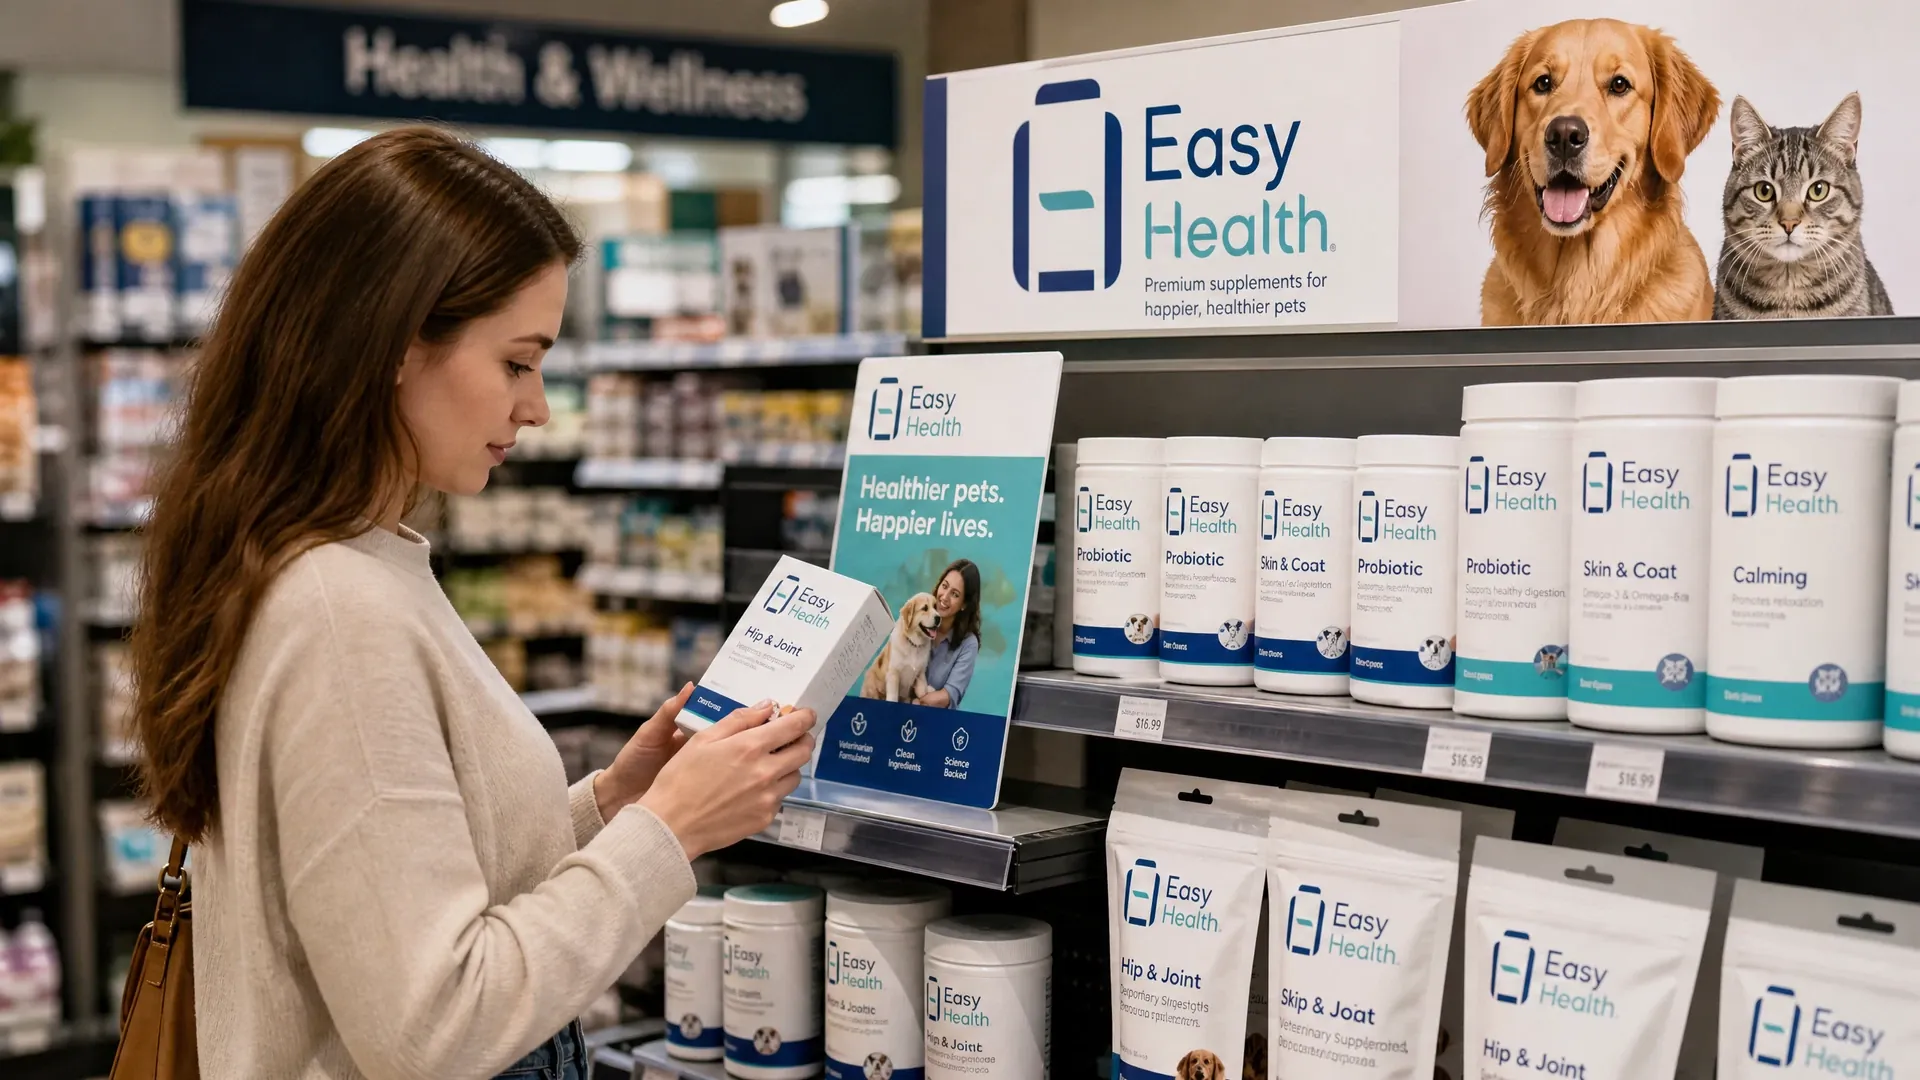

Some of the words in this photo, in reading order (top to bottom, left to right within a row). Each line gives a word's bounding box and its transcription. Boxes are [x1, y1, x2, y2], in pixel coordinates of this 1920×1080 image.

[343, 26, 526, 103] Health
[534, 41, 581, 108] &
[588, 44, 808, 122] Wellness
[1145, 104, 1301, 191] Easy
[1144, 275, 1205, 293] Premium
[1209, 273, 1302, 294] supplements
[1306, 271, 1328, 289] for
[1144, 300, 1203, 321] happier,
[1206, 299, 1270, 317] healthier
[1274, 298, 1307, 318] pets
[910, 385, 956, 415] Easy
[906, 416, 962, 437] Health
[1496, 465, 1547, 491] Easy
[1622, 461, 1680, 489] Easy
[1767, 463, 1828, 492] Easy
[860, 474, 949, 501] Healthier
[953, 479, 1004, 508] pets.
[1495, 491, 1557, 511] Health
[1621, 490, 1690, 510] Health
[1096, 494, 1133, 516] Easy
[1190, 496, 1230, 518] Easy
[1283, 498, 1322, 522] Easy
[1385, 499, 1428, 523] Easy
[1766, 493, 1838, 514] Health
[855, 507, 935, 541] Happier
[940, 511, 993, 538] lives.
[1095, 516, 1141, 531] Health
[1189, 517, 1237, 534] Health
[1281, 521, 1331, 538] Health
[1383, 523, 1437, 541] Health
[1077, 547, 1132, 563] Probiotic
[1166, 550, 1225, 567] Probiotic
[1261, 556, 1278, 571] Skin
[1281, 557, 1289, 571] &
[1291, 557, 1326, 573] Coat
[1358, 558, 1424, 576] Probiotic
[1466, 558, 1531, 576] Probiotic
[1584, 560, 1612, 577] Skin
[1616, 562, 1628, 578] &
[1633, 562, 1677, 580] Coat
[1733, 566, 1808, 590] Calming
[798, 587, 834, 614] Easy
[1493, 586, 1522, 597] healthy
[788, 604, 830, 630] Health
[745, 626, 764, 643] Hip
[764, 634, 774, 646] &
[774, 639, 802, 656] Joint
[1136, 717, 1161, 731] $16.99
[839, 740, 873, 753] Veterinarian
[839, 751, 870, 764] Formulated
[895, 748, 915, 759] Clean
[888, 759, 921, 772] Ingredients
[944, 757, 970, 768] Science
[1451, 753, 1483, 769] $16.99
[944, 768, 967, 780] Backed
[1619, 772, 1655, 788] $16.99
[1166, 874, 1213, 909] Easy
[1161, 904, 1218, 933] Health
[1333, 903, 1389, 939] Easy
[734, 945, 763, 966] Easy
[1328, 934, 1396, 965] Health
[843, 952, 876, 974] Easy
[1121, 957, 1143, 981] Hip
[1147, 964, 1157, 981] &
[1161, 967, 1201, 990] Joint
[1543, 951, 1607, 989] Easy
[842, 973, 883, 990] Health
[944, 987, 981, 1012] Easy
[1281, 988, 1307, 1014] Skip
[1312, 997, 1324, 1015] &
[1539, 983, 1615, 1018] Health
[944, 1008, 989, 1027] Health
[1812, 1008, 1885, 1054] Easy
[941, 1037, 949, 1048] &
[1483, 1038, 1511, 1065] Hip
[1516, 1049, 1529, 1067] &
[1535, 1054, 1586, 1080] Joint
[1804, 1043, 1894, 1080] Health
